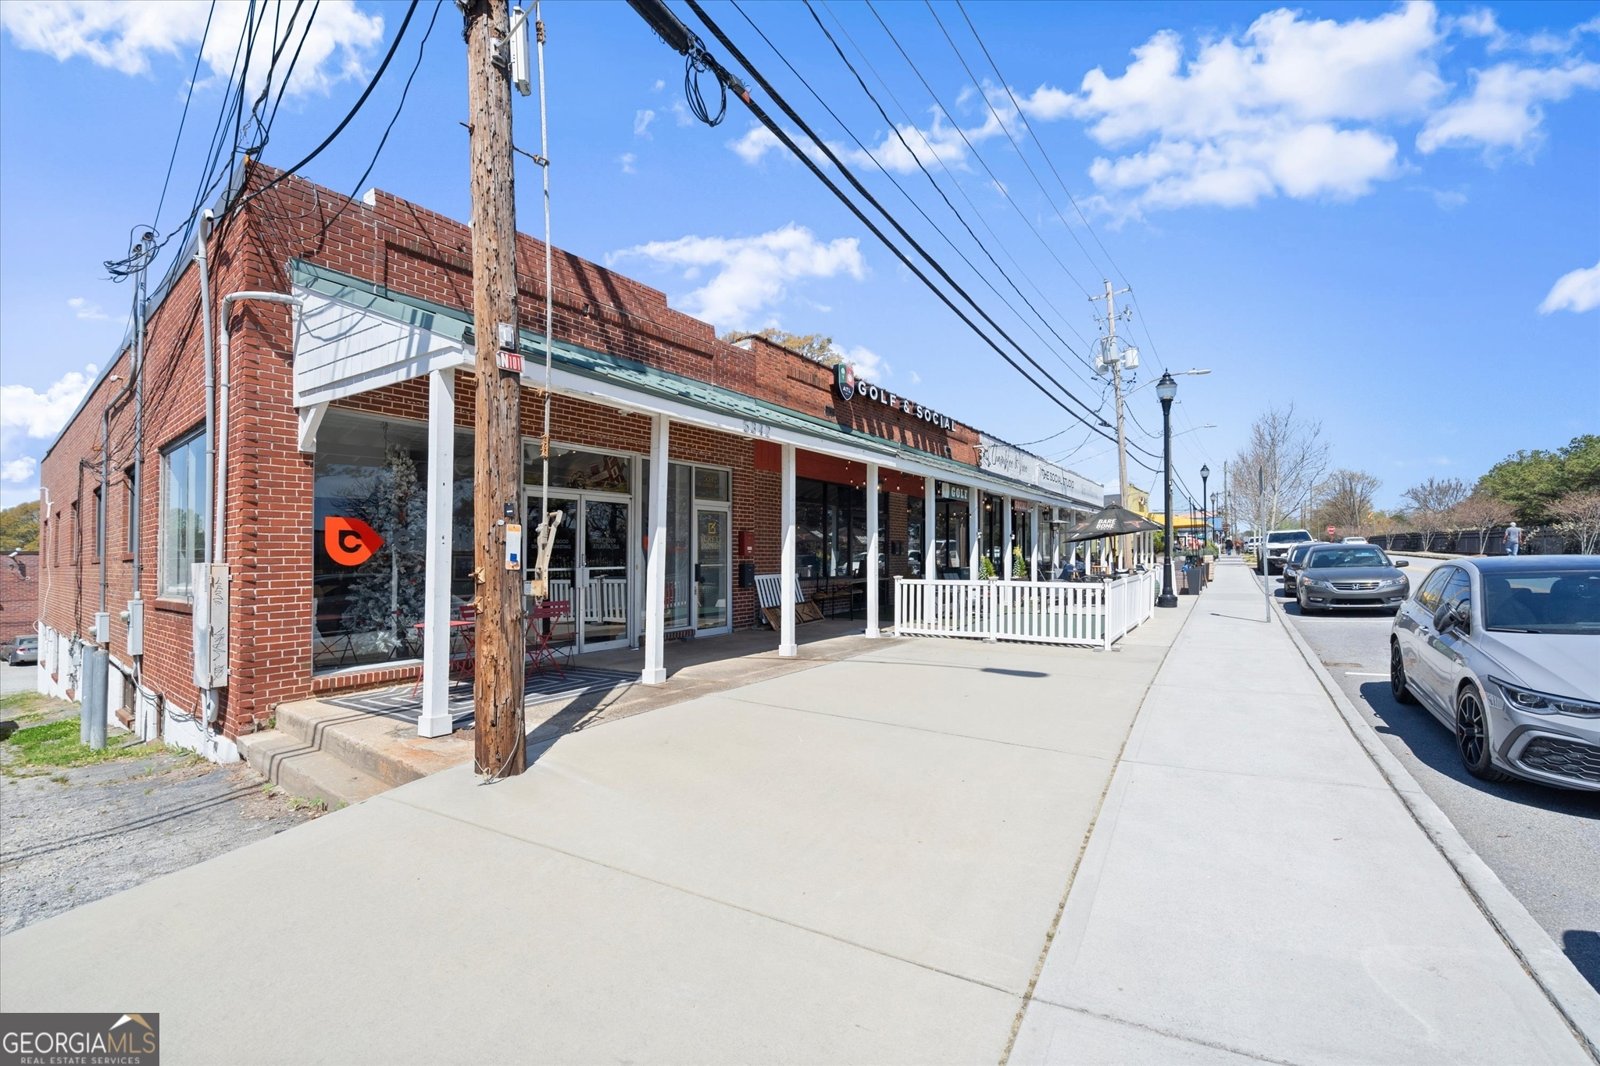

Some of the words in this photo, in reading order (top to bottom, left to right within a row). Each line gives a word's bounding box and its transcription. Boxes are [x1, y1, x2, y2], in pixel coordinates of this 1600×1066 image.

[858, 381, 897, 407] GOLF
[903, 400, 911, 414] &
[916, 405, 957, 432] SOCIAL
